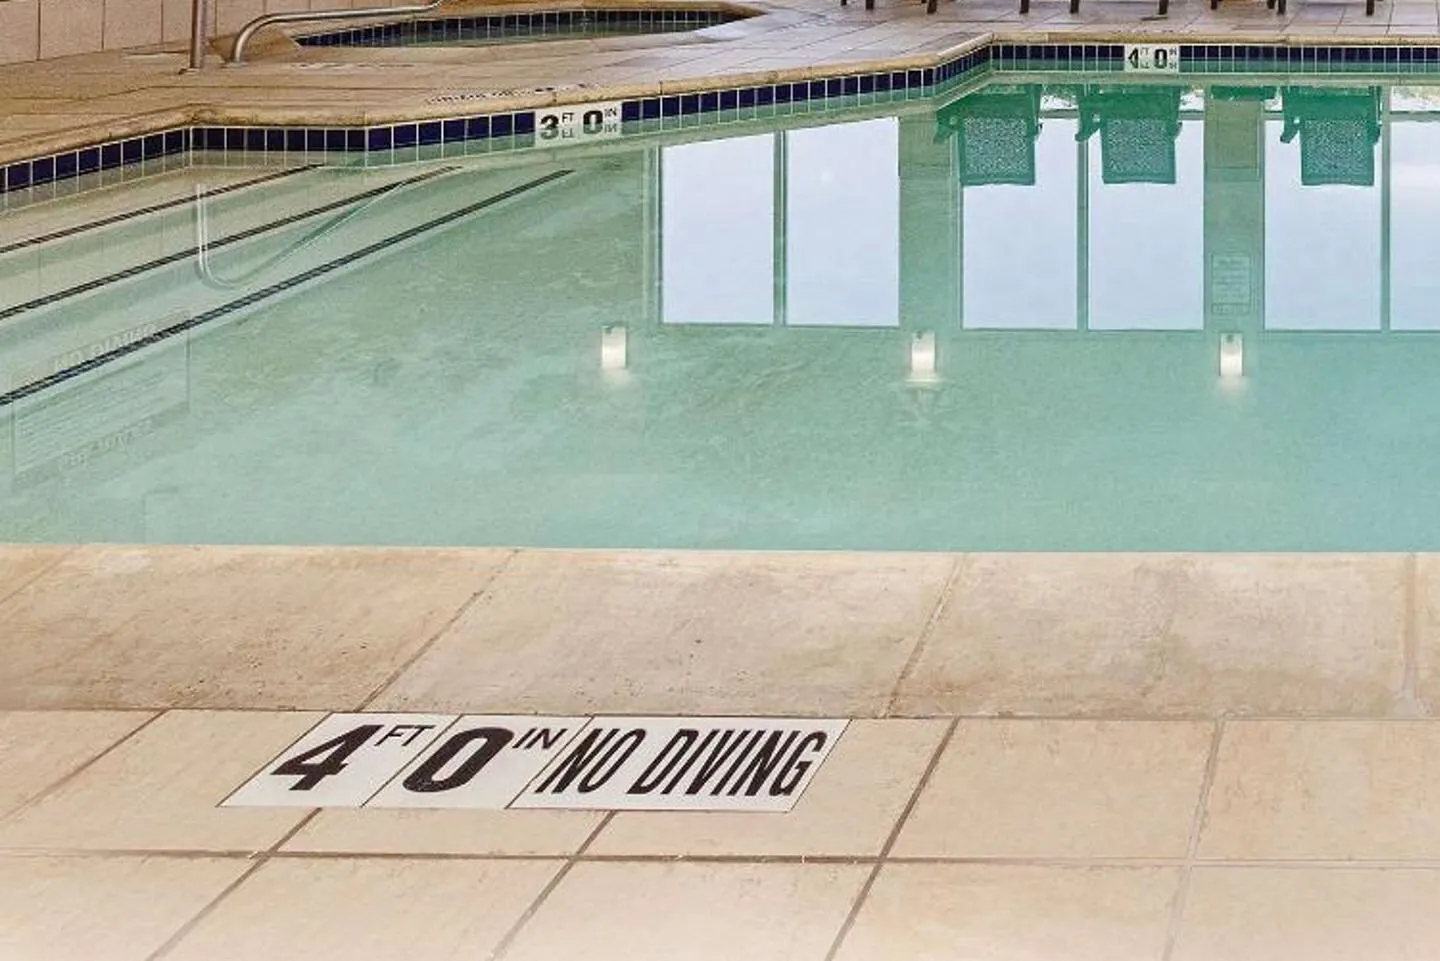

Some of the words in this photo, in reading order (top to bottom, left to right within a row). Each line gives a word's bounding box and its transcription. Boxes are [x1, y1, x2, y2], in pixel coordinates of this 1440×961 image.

[540, 114, 559, 137] 3
[562, 112, 575, 123] FT
[583, 110, 603, 132] 0
[270, 724, 385, 791] 4
[373, 724, 436, 747] FT
[402, 726, 515, 793] 0
[512, 727, 568, 750] IN
[534, 727, 646, 793] NO
[625, 728, 828, 796] DIVING
